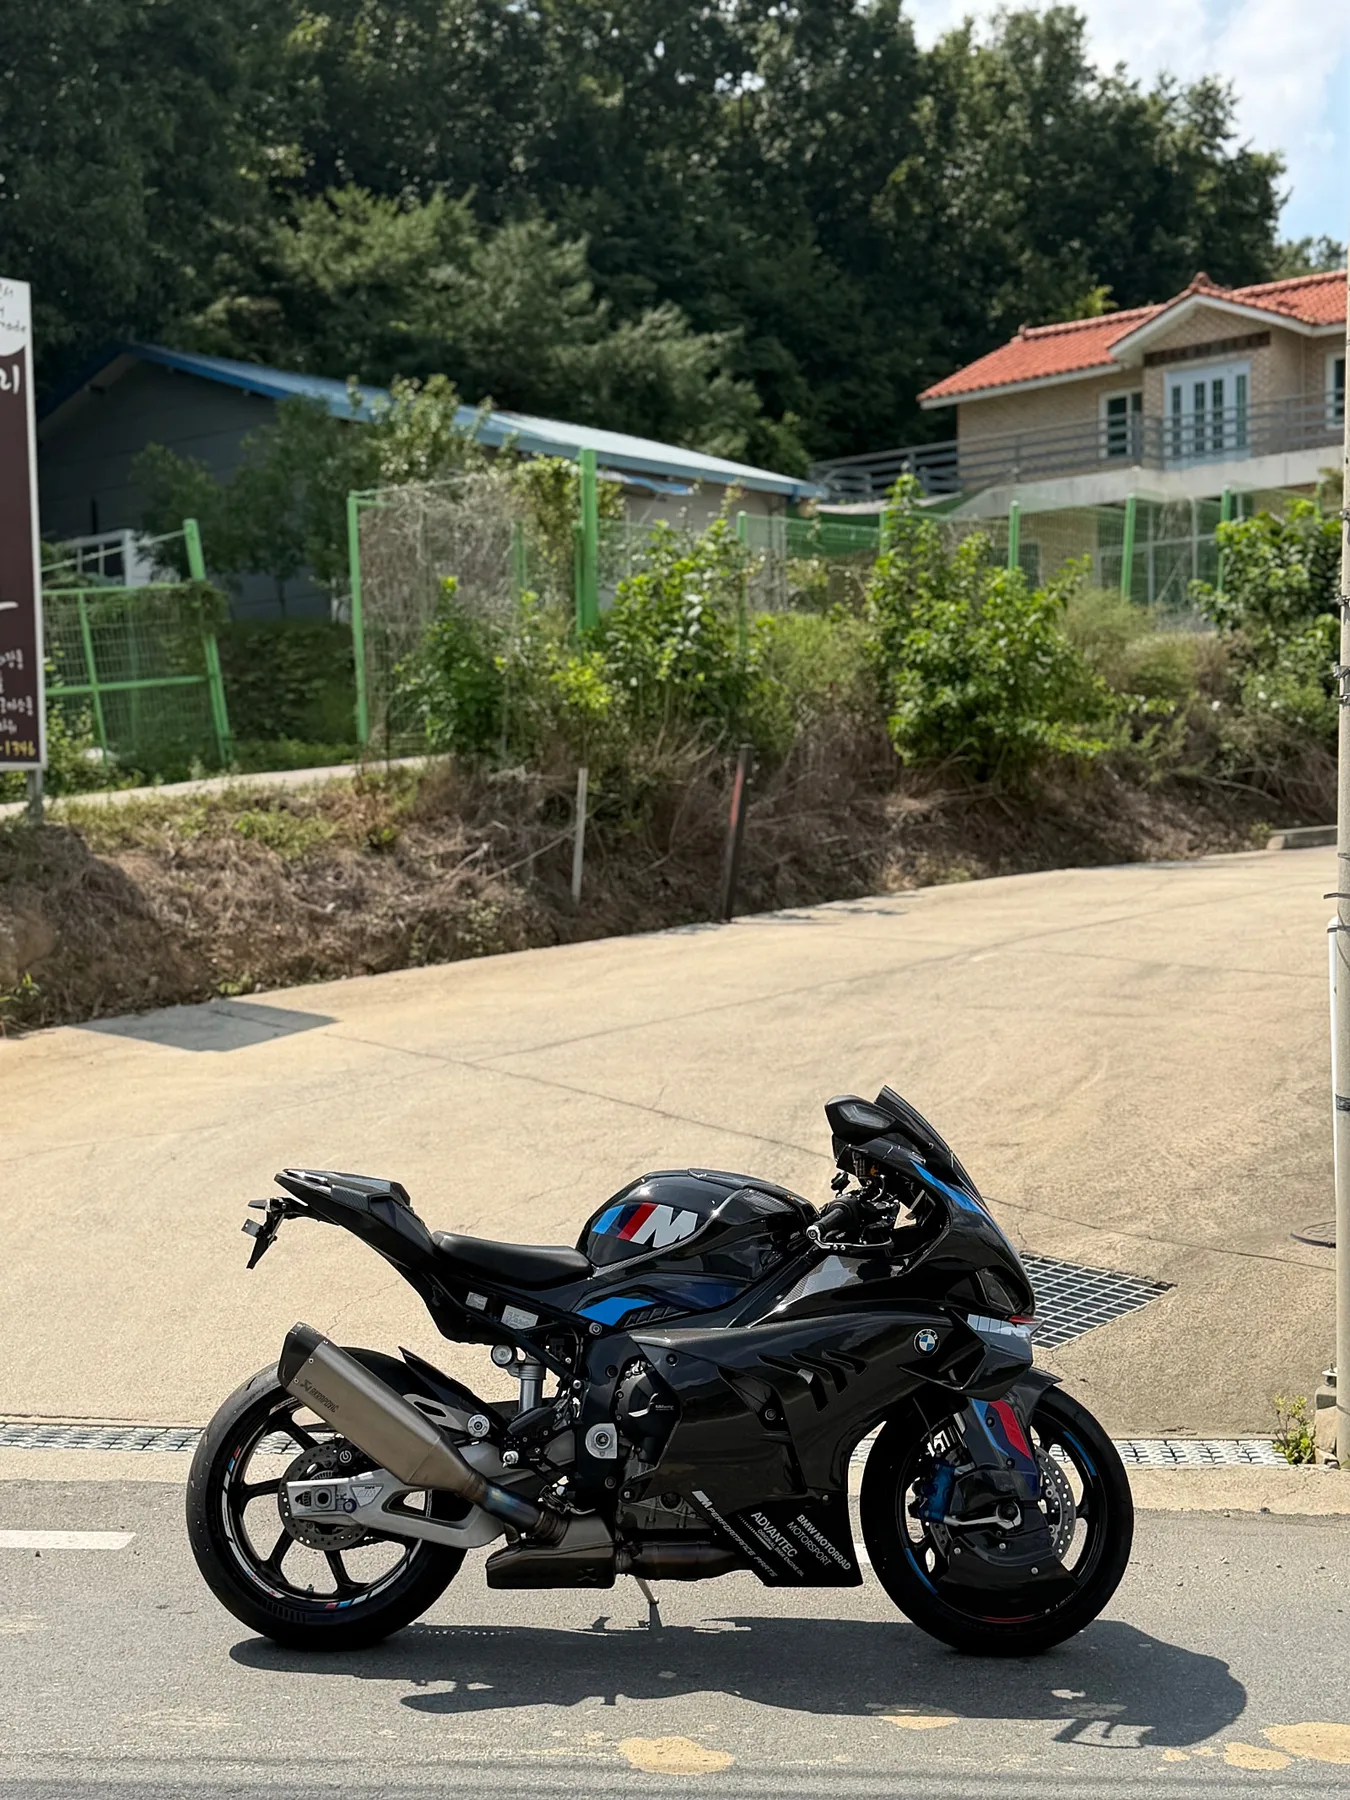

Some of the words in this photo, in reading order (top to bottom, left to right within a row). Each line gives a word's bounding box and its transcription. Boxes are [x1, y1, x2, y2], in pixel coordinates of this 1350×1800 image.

[706, 1507, 756, 1556] PERFORMANCE
[753, 1556, 778, 1577] PARTS
[750, 1511, 798, 1557] ADVANTEC
[786, 1521, 832, 1566] MOTORSPORT
[797, 1514, 818, 1535] BMW
[813, 1532, 851, 1570] MOTORRAD
